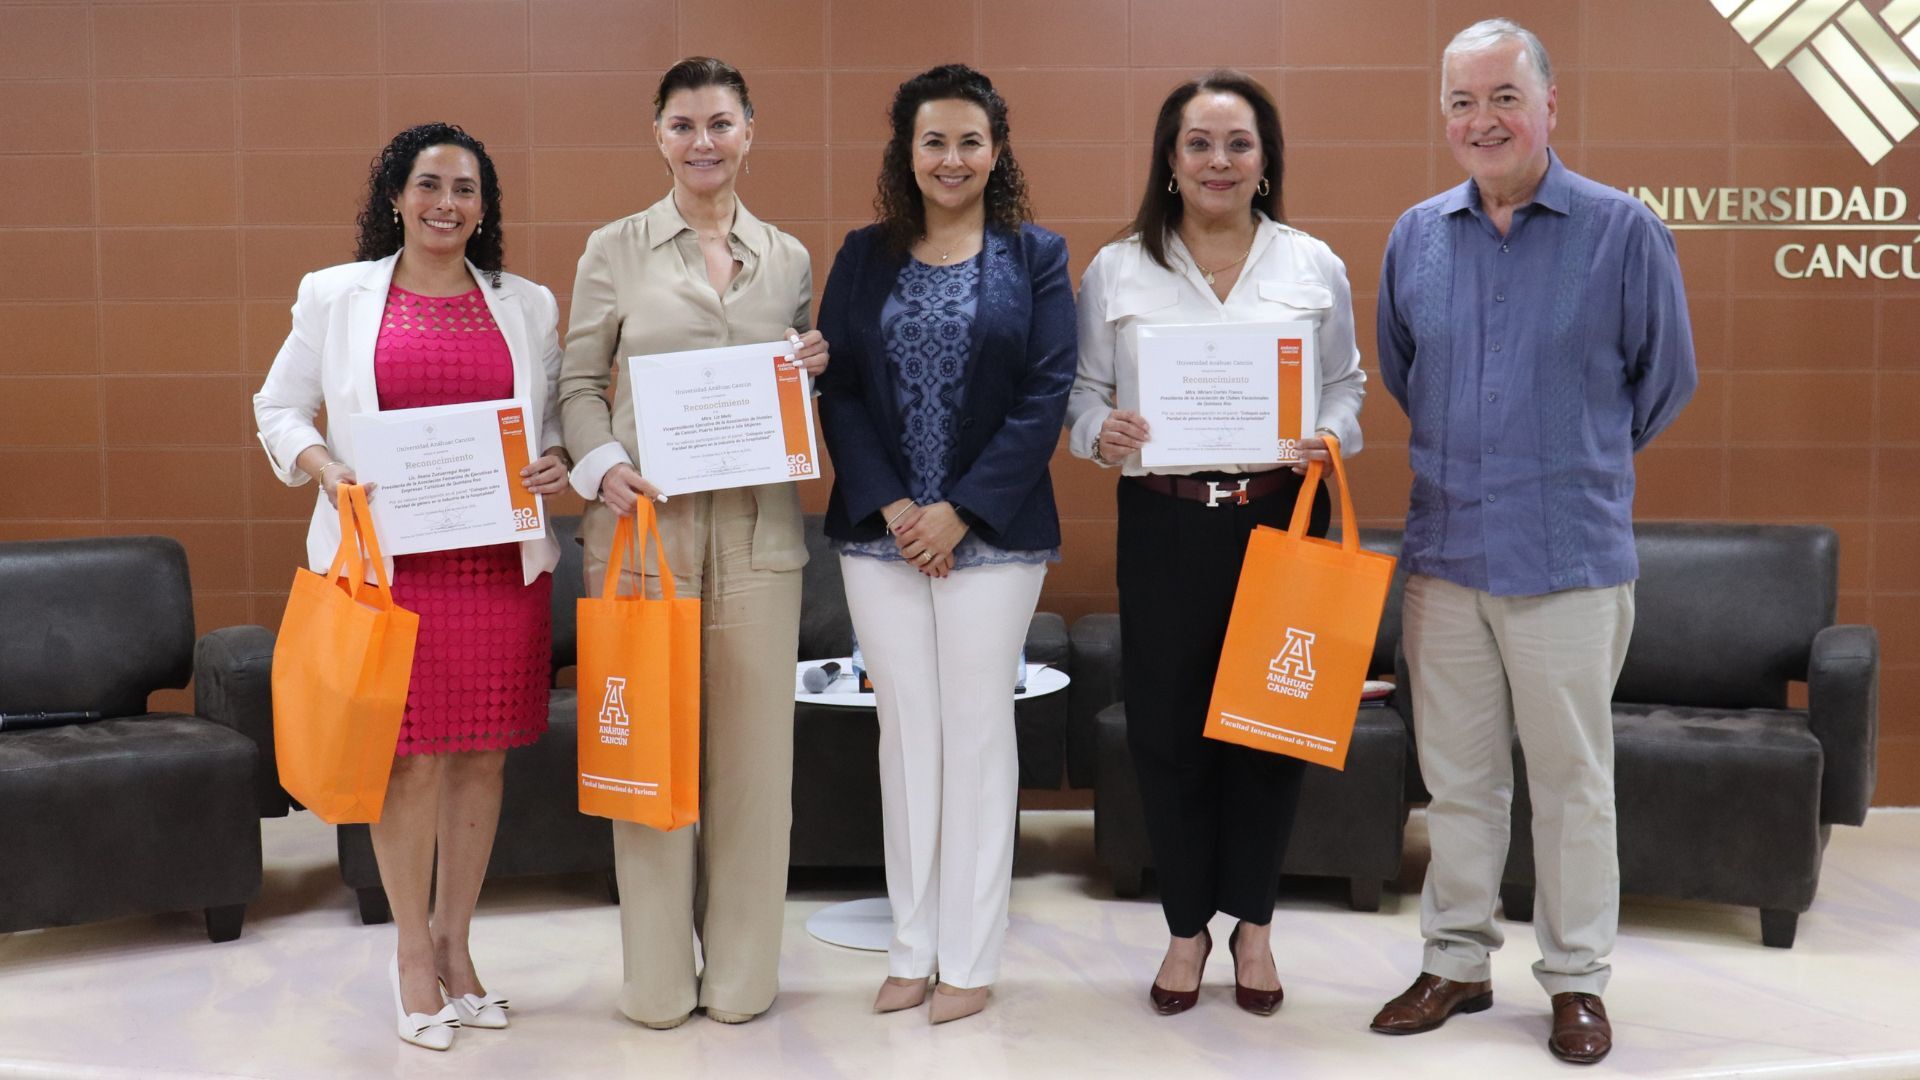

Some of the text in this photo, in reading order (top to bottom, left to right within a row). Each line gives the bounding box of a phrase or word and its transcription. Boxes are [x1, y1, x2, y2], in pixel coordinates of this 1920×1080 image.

[1627, 186, 1907, 222] NIVERSIDAD
[684, 397, 750, 412] Reconocimiento
[396, 443, 429, 452] Universidad
[1277, 438, 1296, 449] GO
[405, 453, 474, 470] Reconocimiento
[787, 453, 807, 464] GO
[788, 462, 812, 475] BIG
[512, 507, 533, 520] GO
[514, 516, 538, 531] BIG
[1266, 672, 1314, 691] ANÁHUAC
[1266, 682, 1308, 699] CANCÚN
[599, 725, 629, 736] ANÁHUAC
[1220, 717, 1334, 753] Facultad Internacional de Turismo
[601, 735, 627, 746] CANCÚN
[634, 788, 657, 796] Turismo
